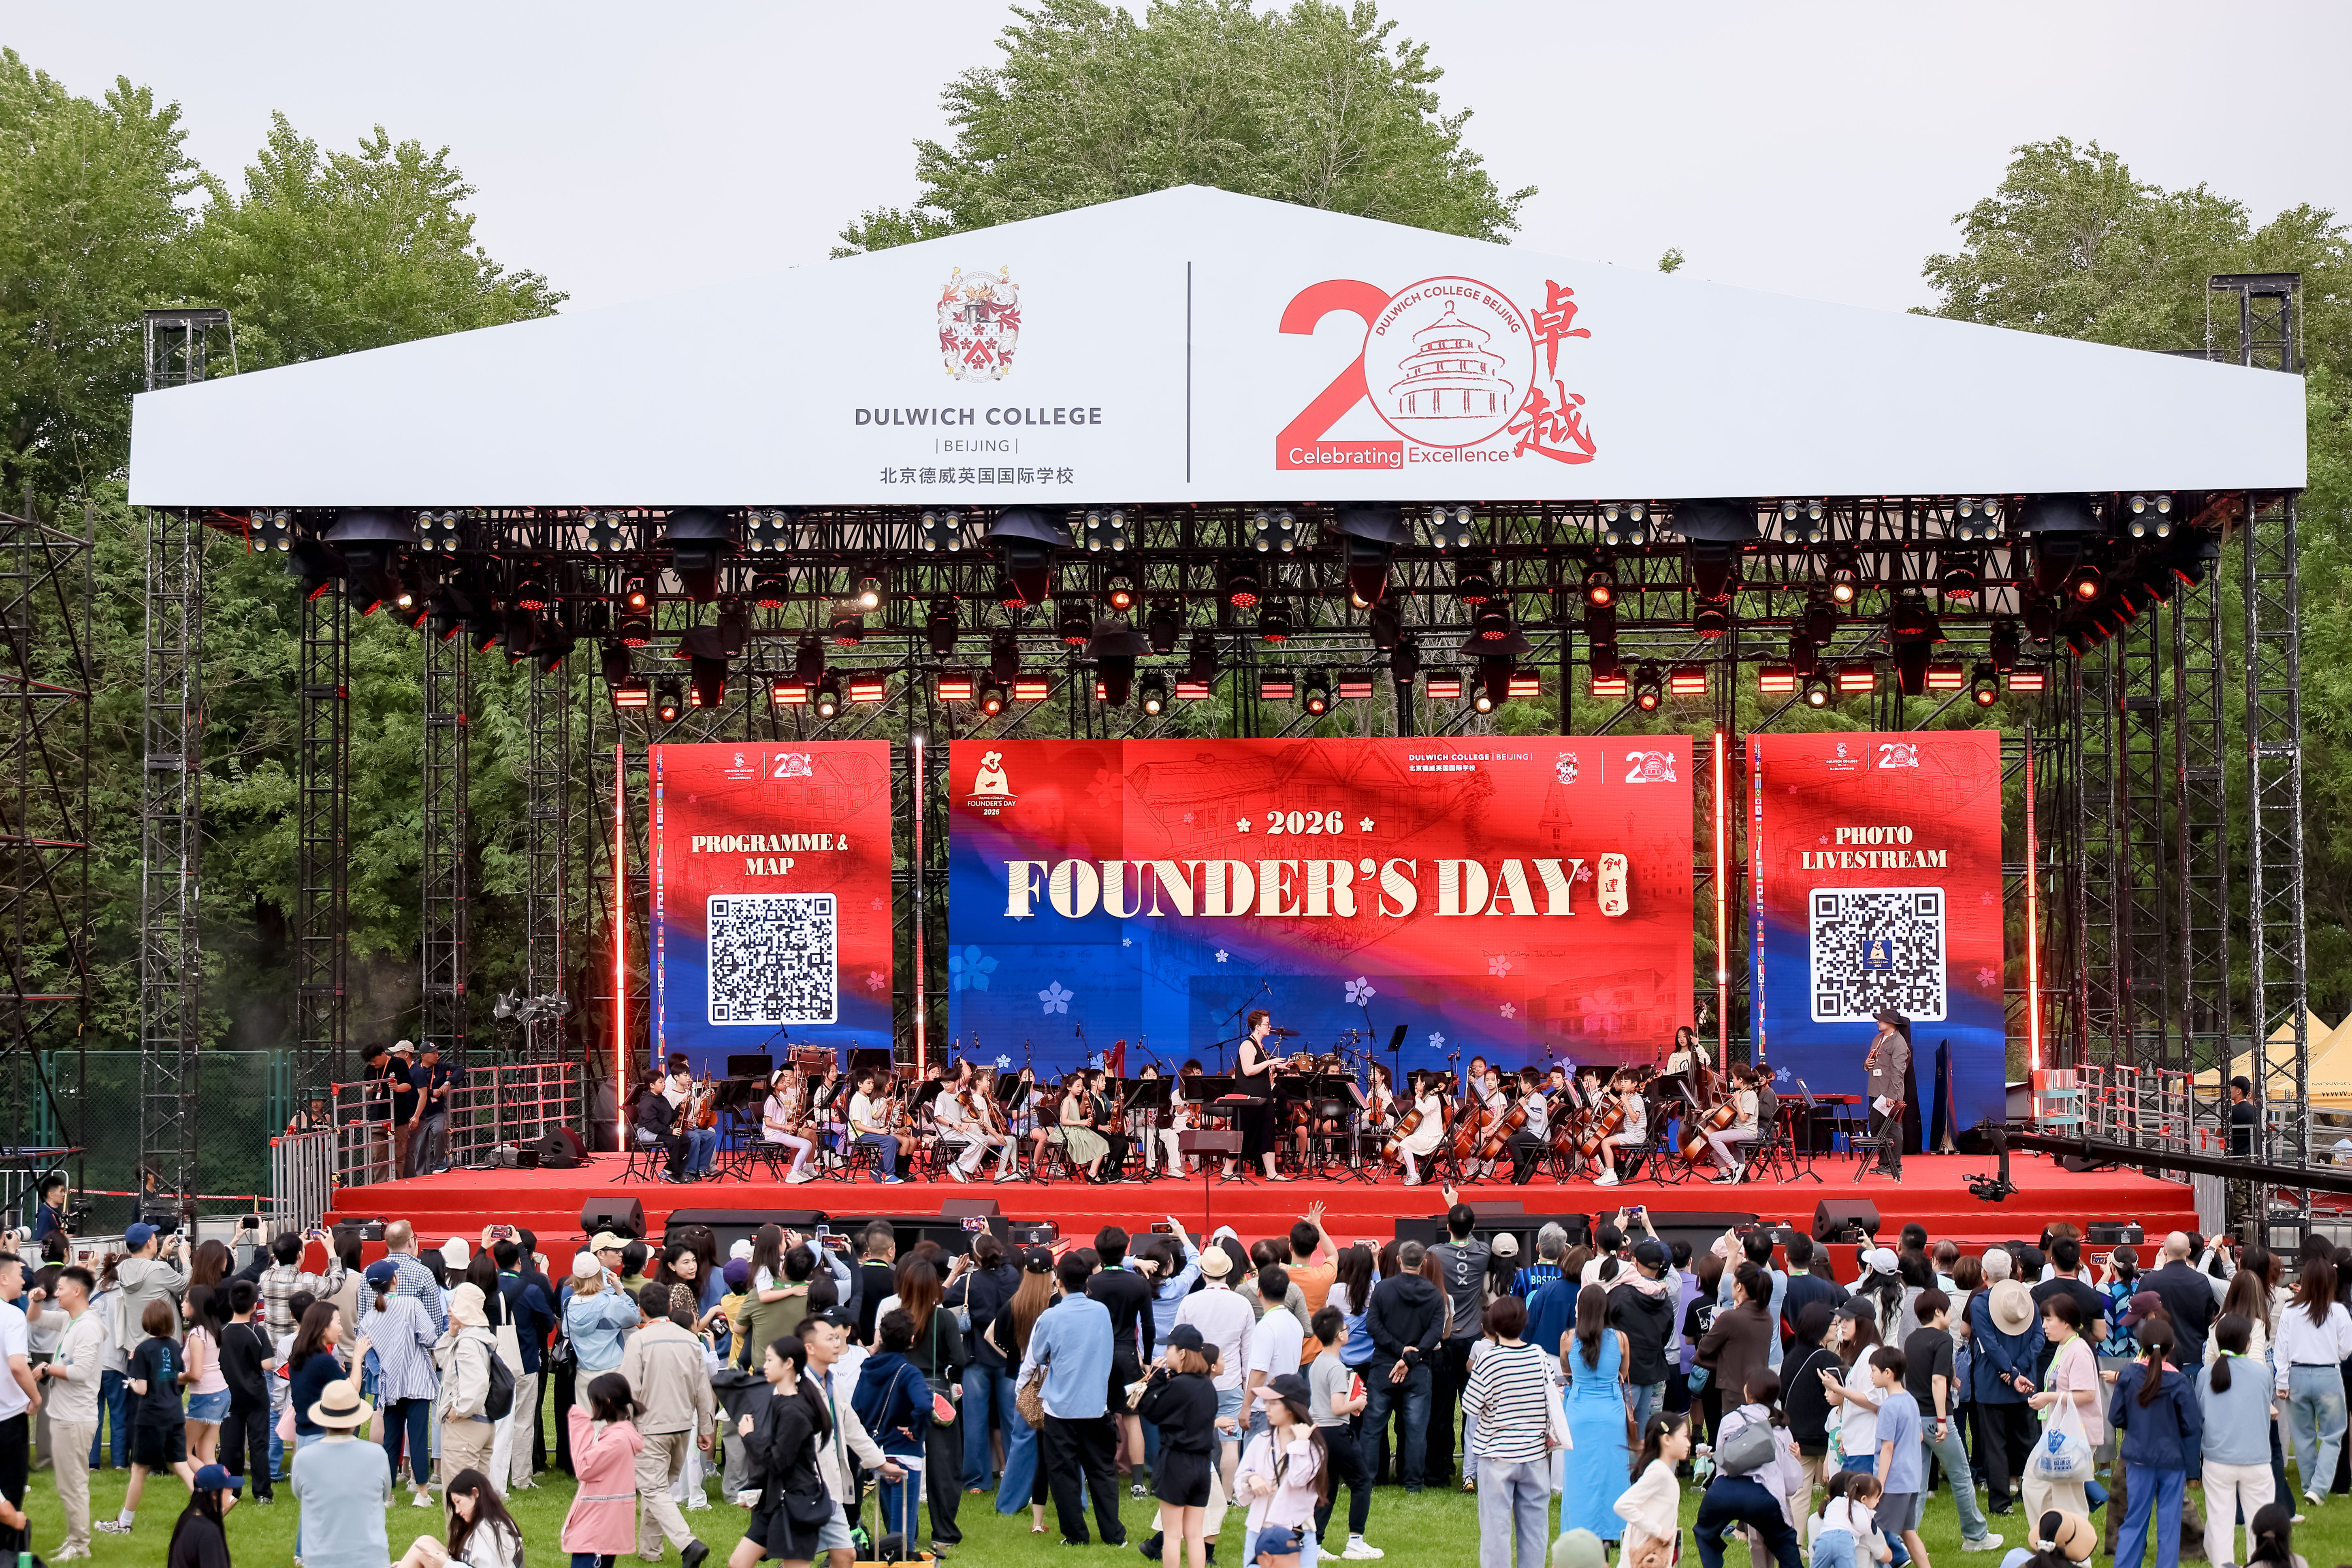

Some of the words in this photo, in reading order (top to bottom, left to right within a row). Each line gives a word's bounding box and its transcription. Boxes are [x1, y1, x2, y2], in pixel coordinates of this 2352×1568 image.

[1375, 292, 1421, 337] DULWICH
[1424, 286, 1481, 300] COLLEGE
[1482, 294, 1521, 335] BEIJING
[1508, 279, 1597, 465] 卓越
[855, 408, 975, 426] DULWICH
[985, 407, 1102, 425] COLLEGE
[945, 440, 1010, 452] BEIJING
[1289, 447, 1402, 468] Celebrating
[1409, 446, 1509, 463] Excellence
[880, 467, 1074, 485] 北京德威英国国际学校
[1267, 811, 1343, 835] 2026
[691, 834, 833, 853] PROGRAMME
[837, 834, 849, 851] &
[1835, 826, 1913, 845] PHOTO
[745, 858, 794, 875] MAP
[1801, 849, 1947, 870] LIVESTREAM
[1004, 858, 1418, 918] FOUNDER'S
[1433, 858, 1585, 917] DAY
[1531, 1275, 1561, 1284] BASTO
